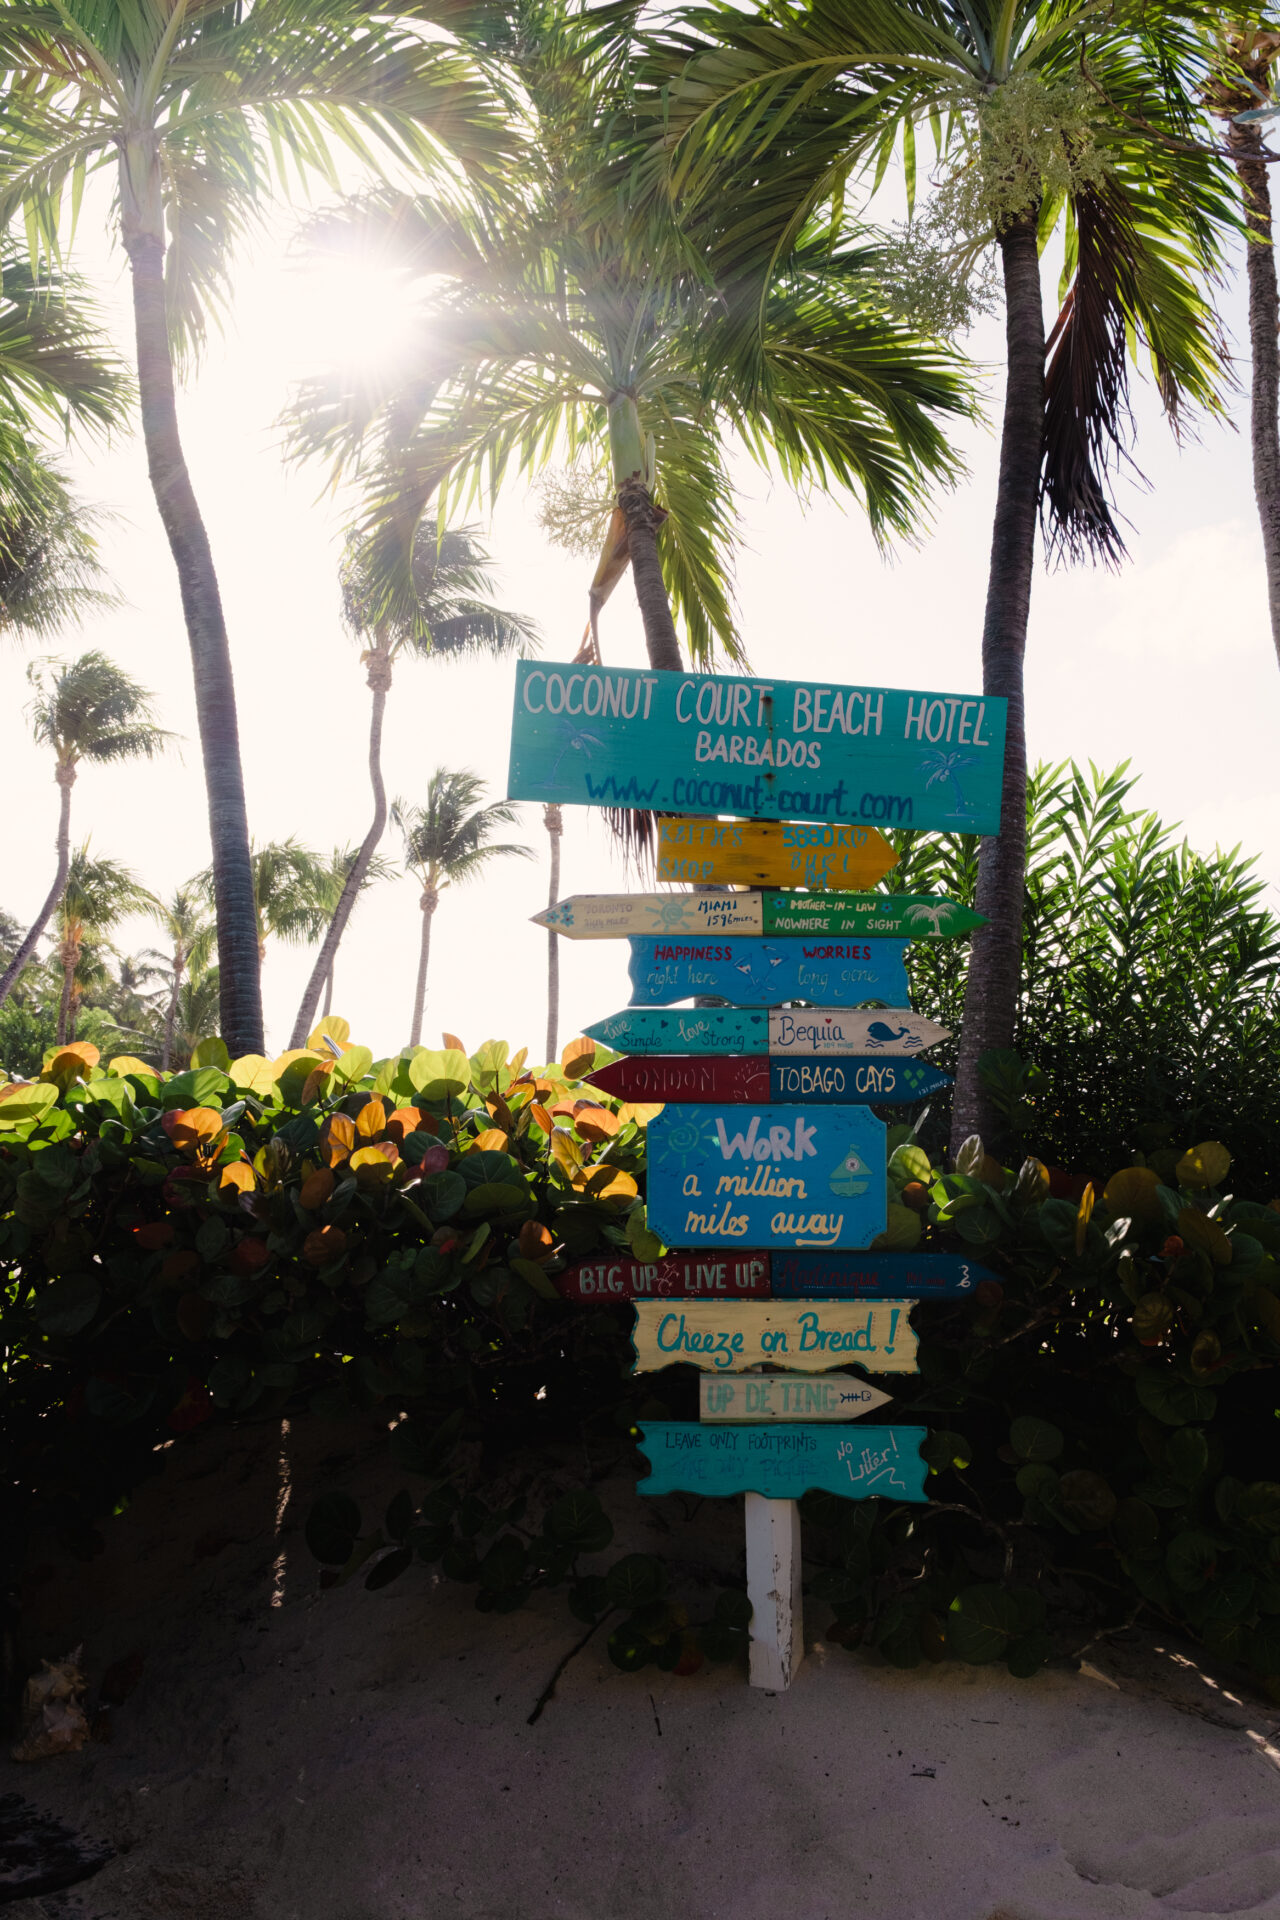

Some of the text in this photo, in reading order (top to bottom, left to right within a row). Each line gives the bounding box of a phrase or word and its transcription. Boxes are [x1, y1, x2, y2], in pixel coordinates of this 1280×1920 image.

[523, 670, 989, 747] COCONUT COURT BEACH HOTEL
[695, 731, 822, 769] BARBADOS
[781, 824, 834, 848] 3880
[659, 858, 714, 879] SHOP
[698, 900, 737, 914] MIAMI
[707, 913, 732, 927] 1596
[775, 917, 902, 930] NOWHERE IN SIGHT
[654, 945, 733, 961] HAPPINESS
[802, 946, 871, 960] WORRIES
[647, 965, 718, 995] right here
[620, 1030, 663, 1053] Simple
[677, 1018, 710, 1042] love
[702, 1032, 745, 1053] Strong
[778, 1016, 846, 1049] Bequia
[620, 1066, 716, 1092] LONDON
[776, 1065, 896, 1094] TOBAGO CAYS
[682, 1164, 808, 1199] a million
[684, 1201, 844, 1246] miles away
[579, 1265, 658, 1294] BIG UP
[684, 1260, 765, 1290] LIVE UP
[778, 1259, 880, 1294] Martinique
[657, 1313, 745, 1368] Cheeze
[761, 1330, 789, 1352] on
[707, 1382, 839, 1413] UP DE TING
[665, 1431, 818, 1455] LEAVE ONLY FOOTPRINTS
